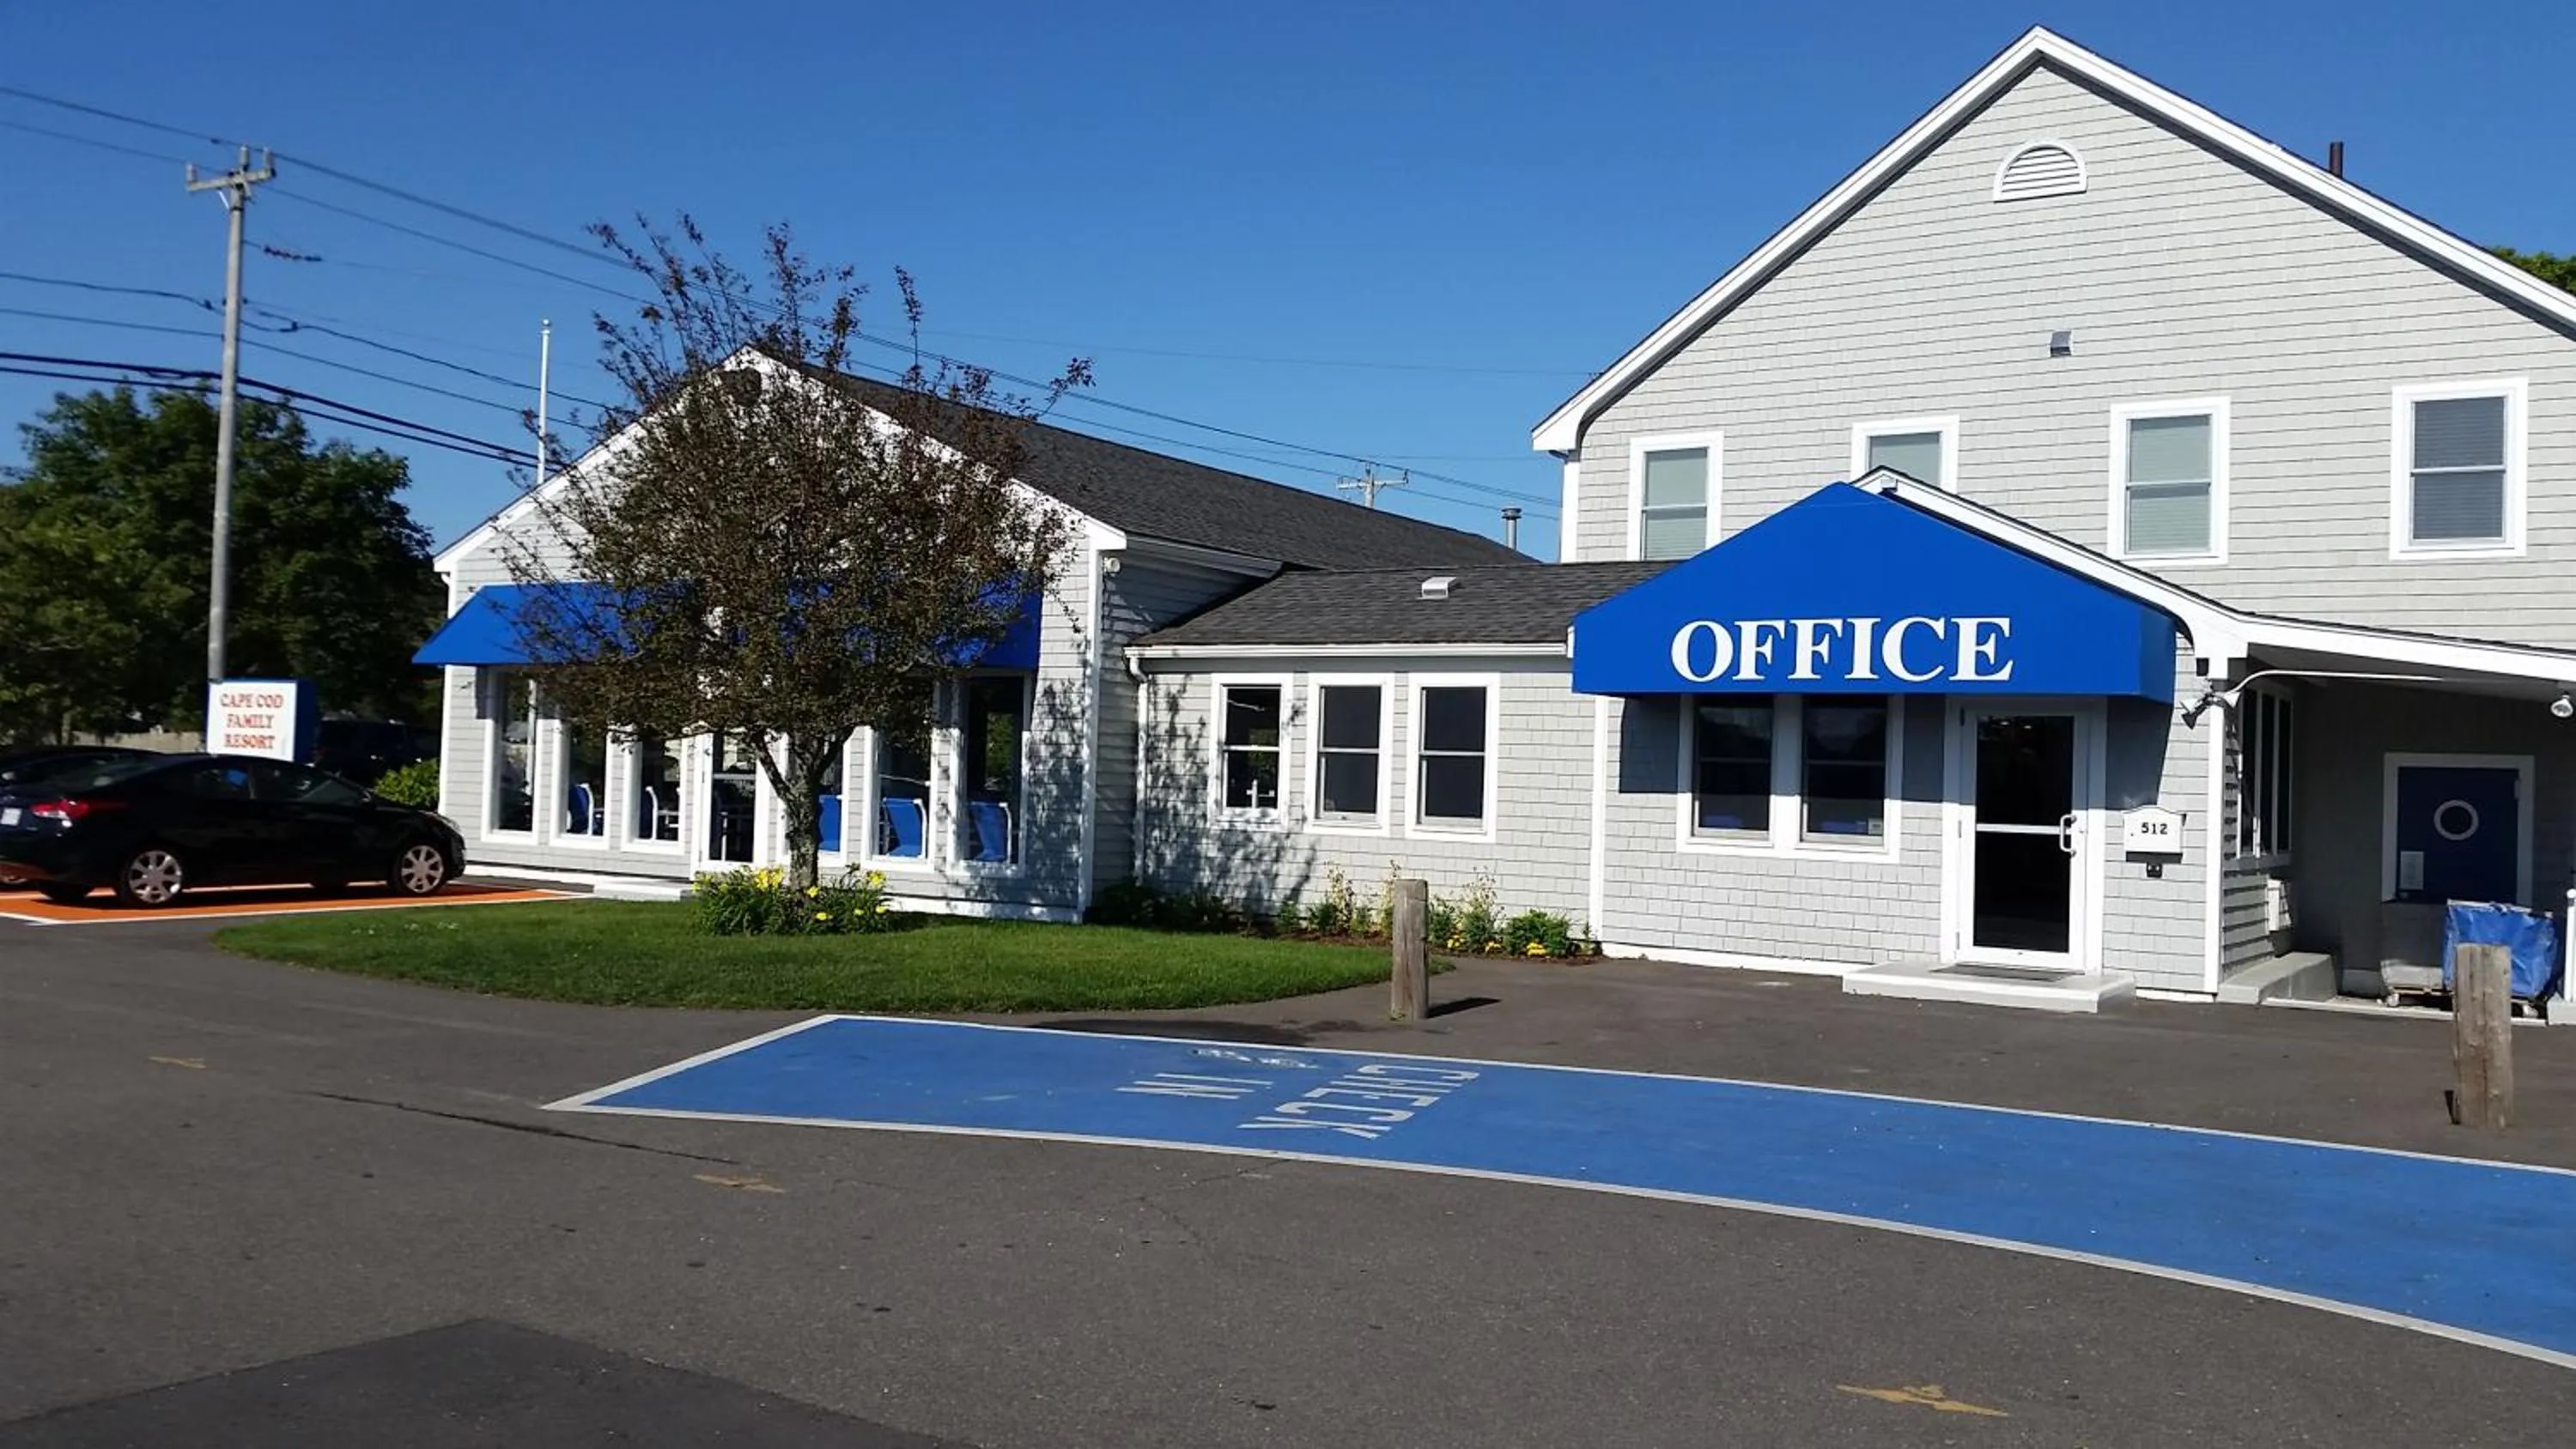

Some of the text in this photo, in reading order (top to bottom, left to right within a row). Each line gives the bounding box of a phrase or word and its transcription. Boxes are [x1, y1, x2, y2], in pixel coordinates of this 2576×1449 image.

[1670, 615, 2014, 683] OFFICE
[220, 693, 284, 709] CAPE COD
[227, 713, 275, 729] FAMILY
[223, 733, 276, 749] RESORT
[2141, 822, 2169, 835] 512
[1115, 1072, 1274, 1100] IN
[1236, 1064, 1480, 1140] CHECK
